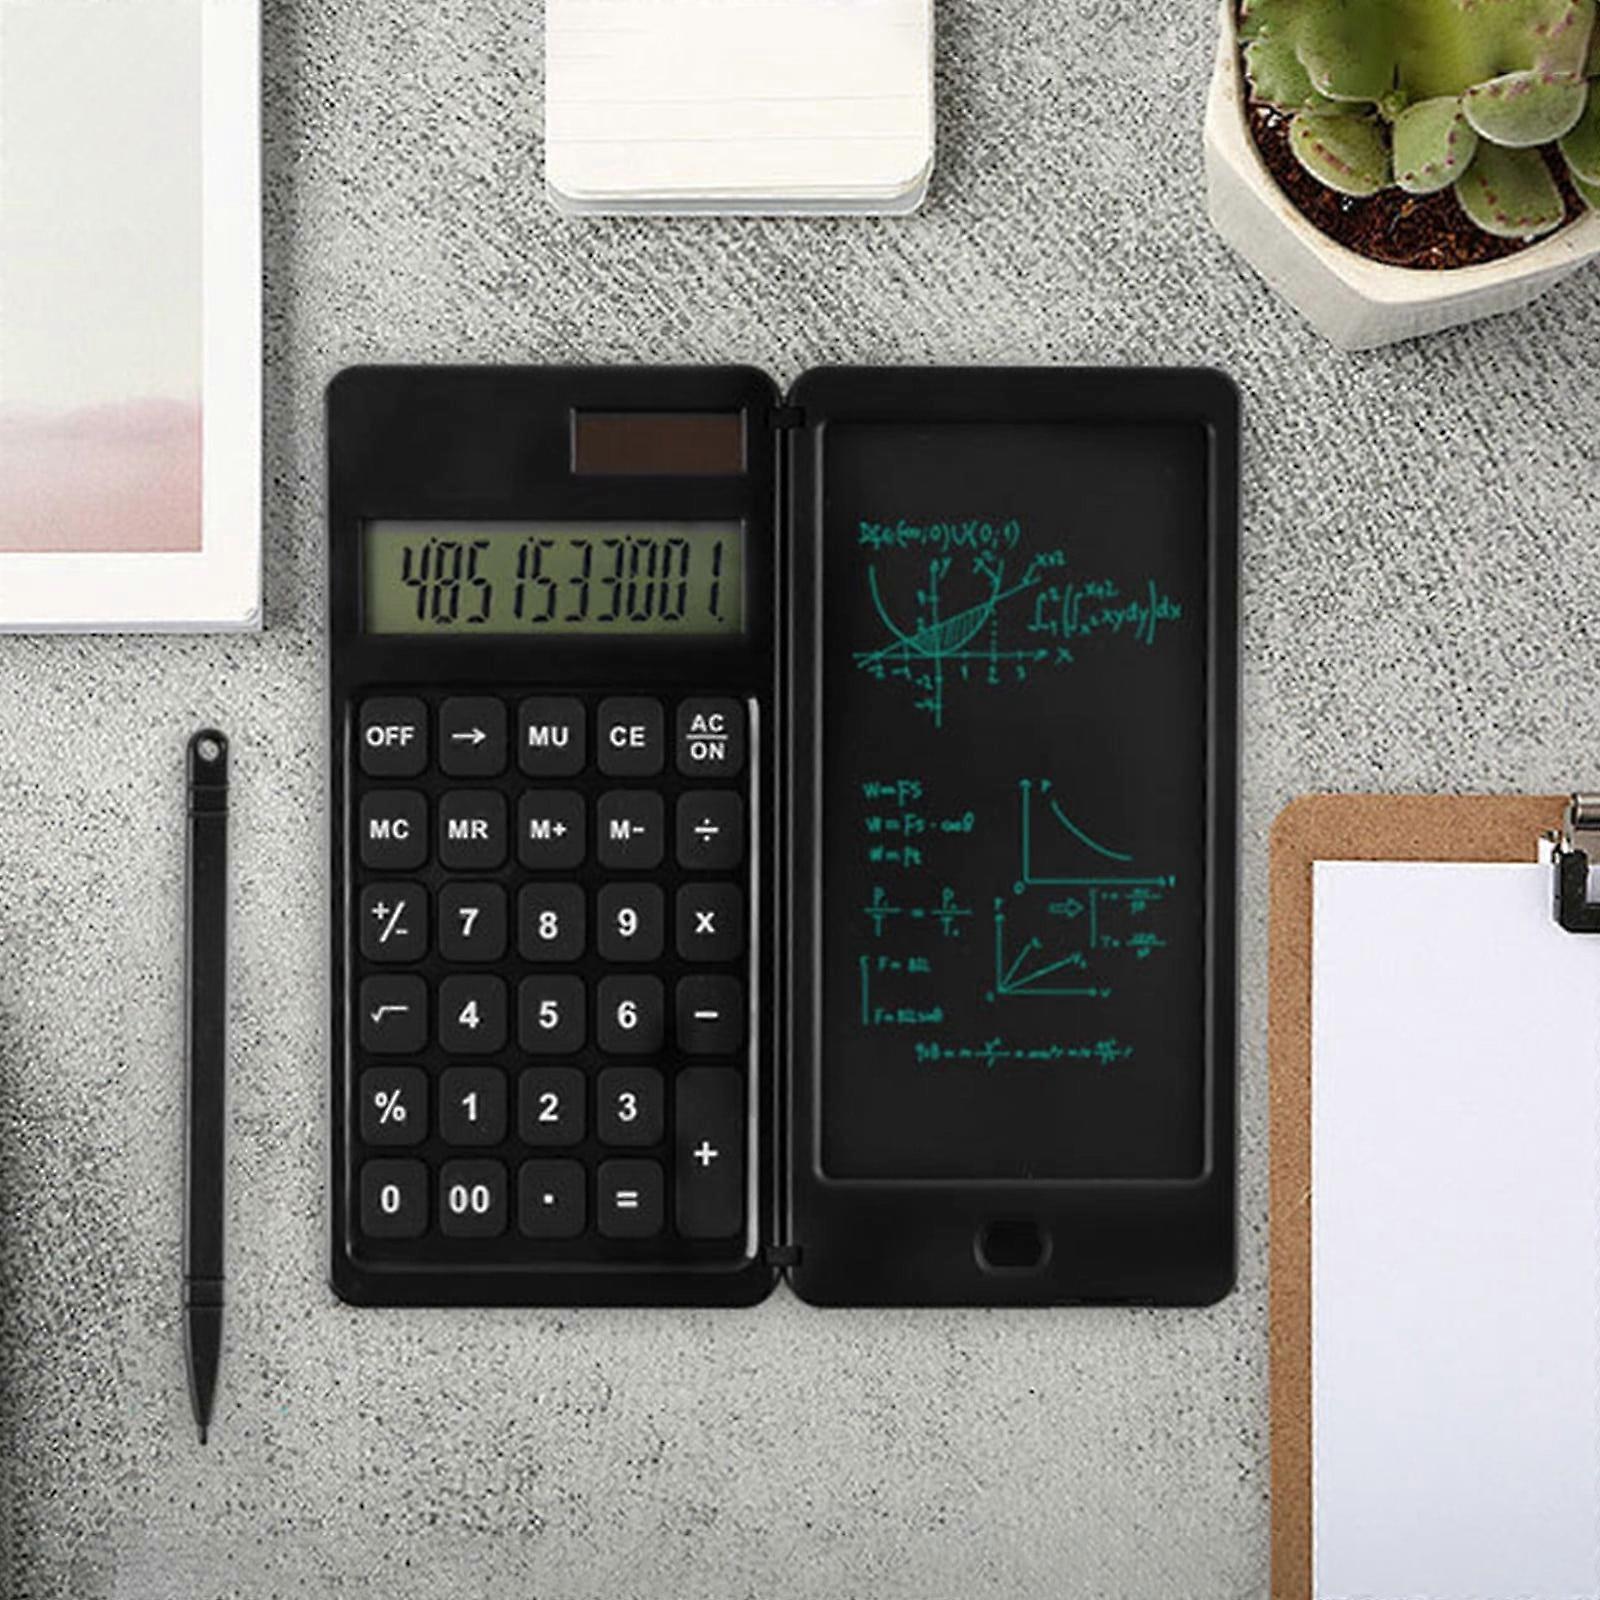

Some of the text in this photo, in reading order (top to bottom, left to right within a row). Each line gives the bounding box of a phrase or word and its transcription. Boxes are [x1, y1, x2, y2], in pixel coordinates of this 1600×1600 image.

[365, 725, 415, 747] OFF
[528, 725, 569, 747] MU
[609, 725, 646, 747] CE
[690, 713, 724, 734] AC
[690, 741, 725, 761] ON
[369, 818, 409, 840] MC
[448, 819, 489, 840] MR
[530, 819, 567, 840] M+
[610, 819, 645, 840] M-
[459, 907, 479, 937] 7
[538, 910, 558, 940] 8
[617, 907, 638, 937] 9
[458, 1000, 480, 1029] 4
[538, 1000, 559, 1029] 5
[617, 1000, 638, 1029] 6
[374, 1089, 407, 1124] %
[462, 1092, 477, 1121] 1
[538, 1092, 559, 1122] 2
[618, 1092, 638, 1122] 3
[380, 1184, 401, 1214] 0
[449, 1184, 490, 1214] 00
